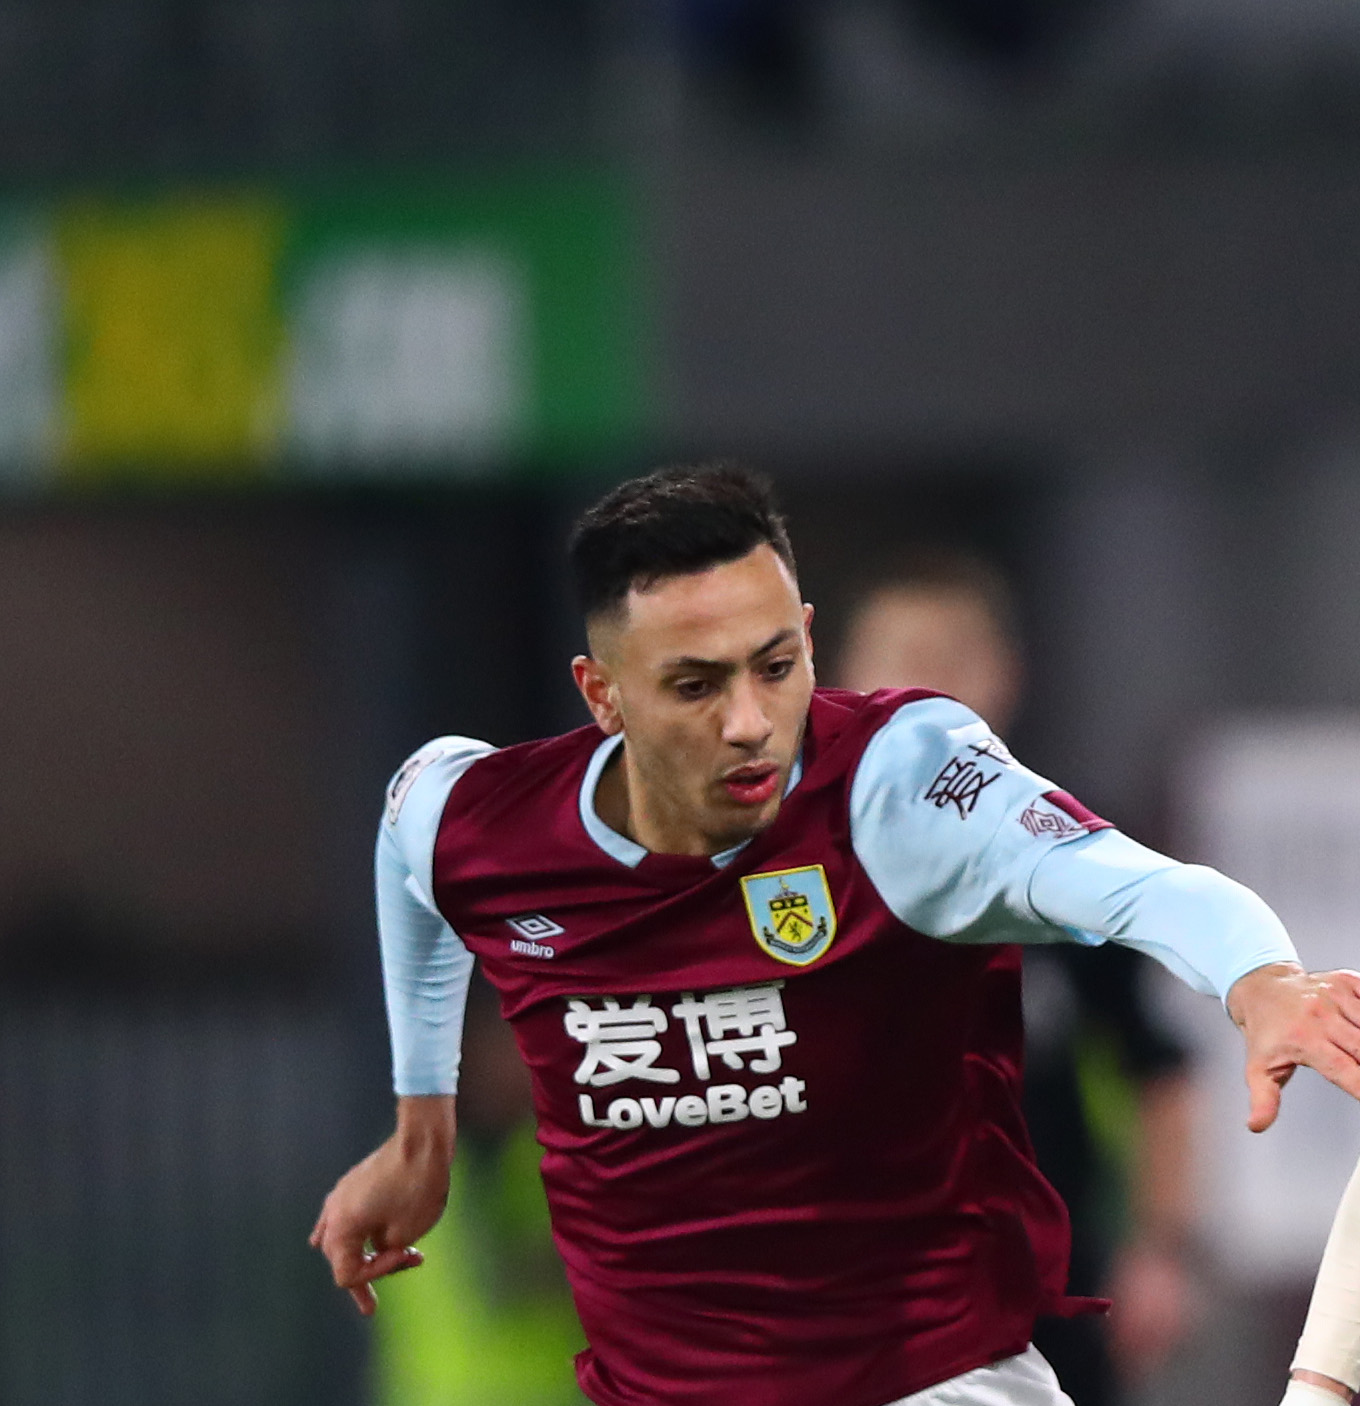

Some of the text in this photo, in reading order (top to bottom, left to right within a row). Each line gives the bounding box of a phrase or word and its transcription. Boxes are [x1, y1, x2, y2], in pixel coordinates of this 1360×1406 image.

[510, 939, 555, 959] umbro
[564, 980, 798, 1087] 爱博
[578, 1076, 808, 1130] LoveBet
